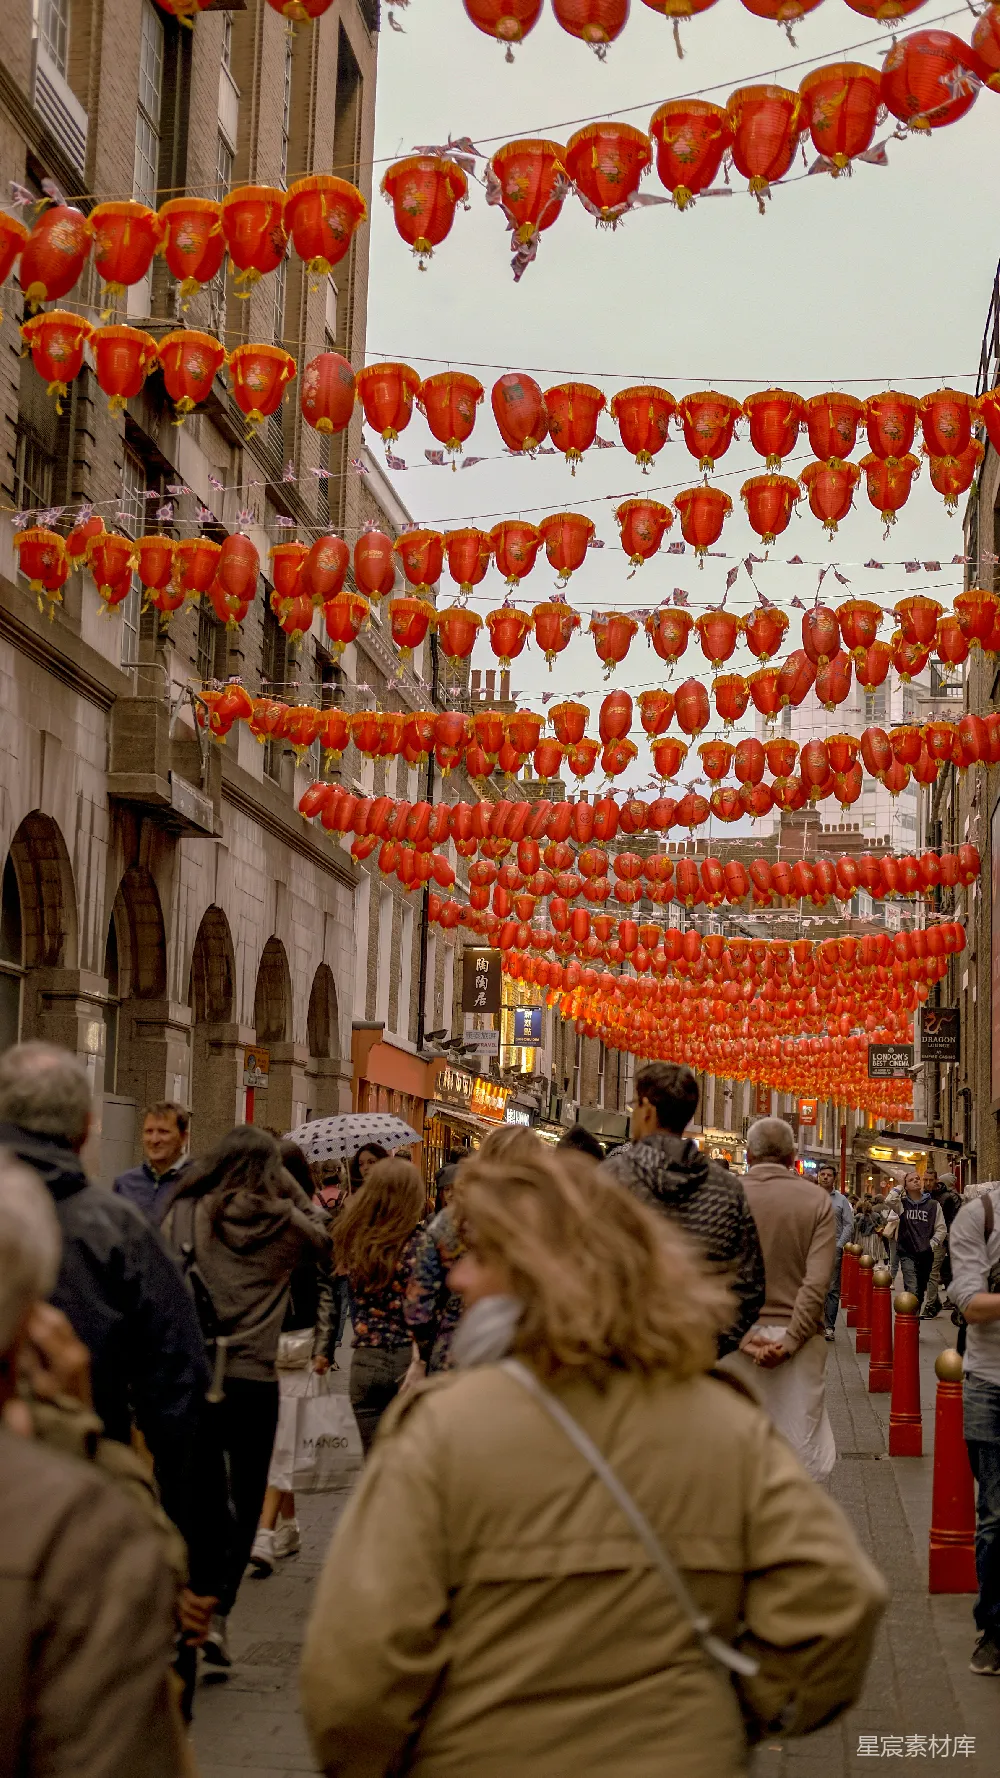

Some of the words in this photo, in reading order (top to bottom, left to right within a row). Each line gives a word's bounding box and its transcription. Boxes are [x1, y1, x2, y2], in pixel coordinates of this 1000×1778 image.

[474, 957, 489, 1006] 陶陶居
[872, 1053, 909, 1061] LONDON'S
[906, 1209, 929, 1222] NIKE
[303, 1436, 349, 1449] MANGO
